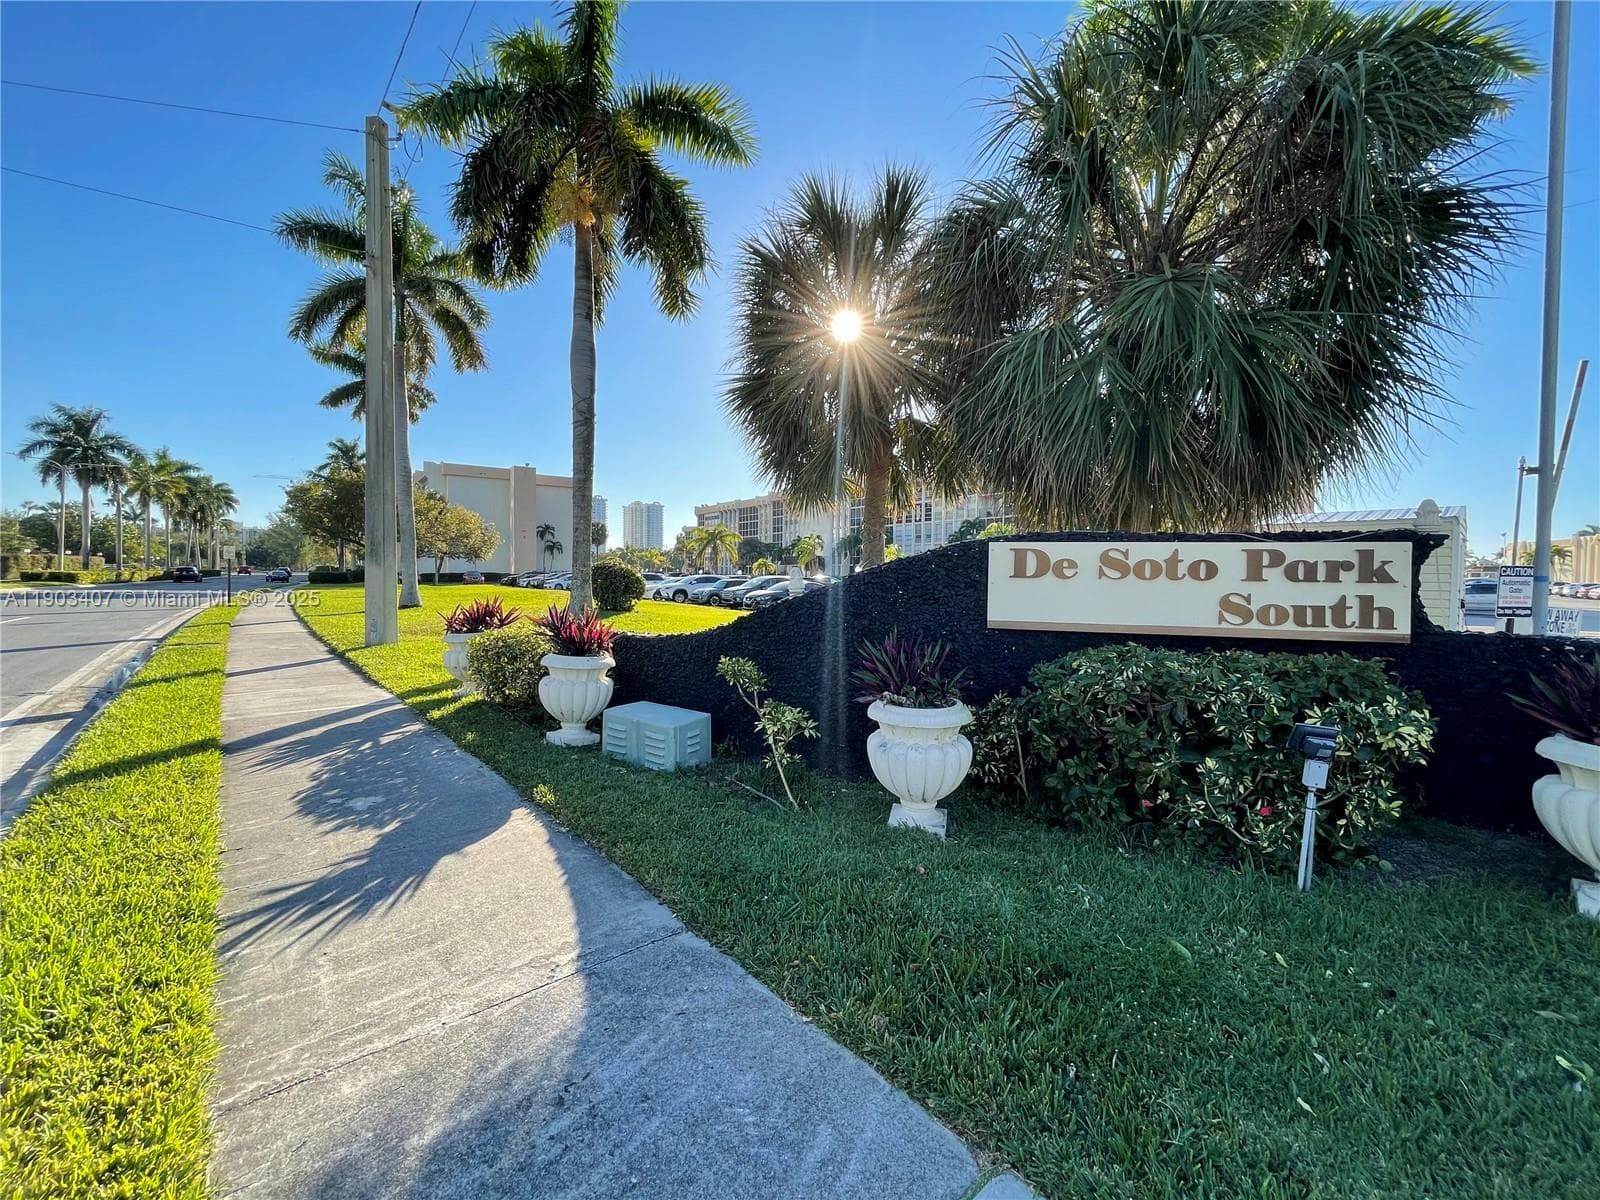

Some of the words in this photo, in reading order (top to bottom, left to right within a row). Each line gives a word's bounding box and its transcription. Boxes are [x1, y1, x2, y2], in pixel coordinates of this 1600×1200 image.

[1008, 548, 1078, 580] De
[1098, 548, 1219, 582] Soto
[1241, 549, 1399, 584] Park
[1501, 567, 1534, 576] CAUTION
[1218, 592, 1398, 630] South
[1554, 609, 1580, 622] AWAY
[1547, 620, 1566, 633] ONE
